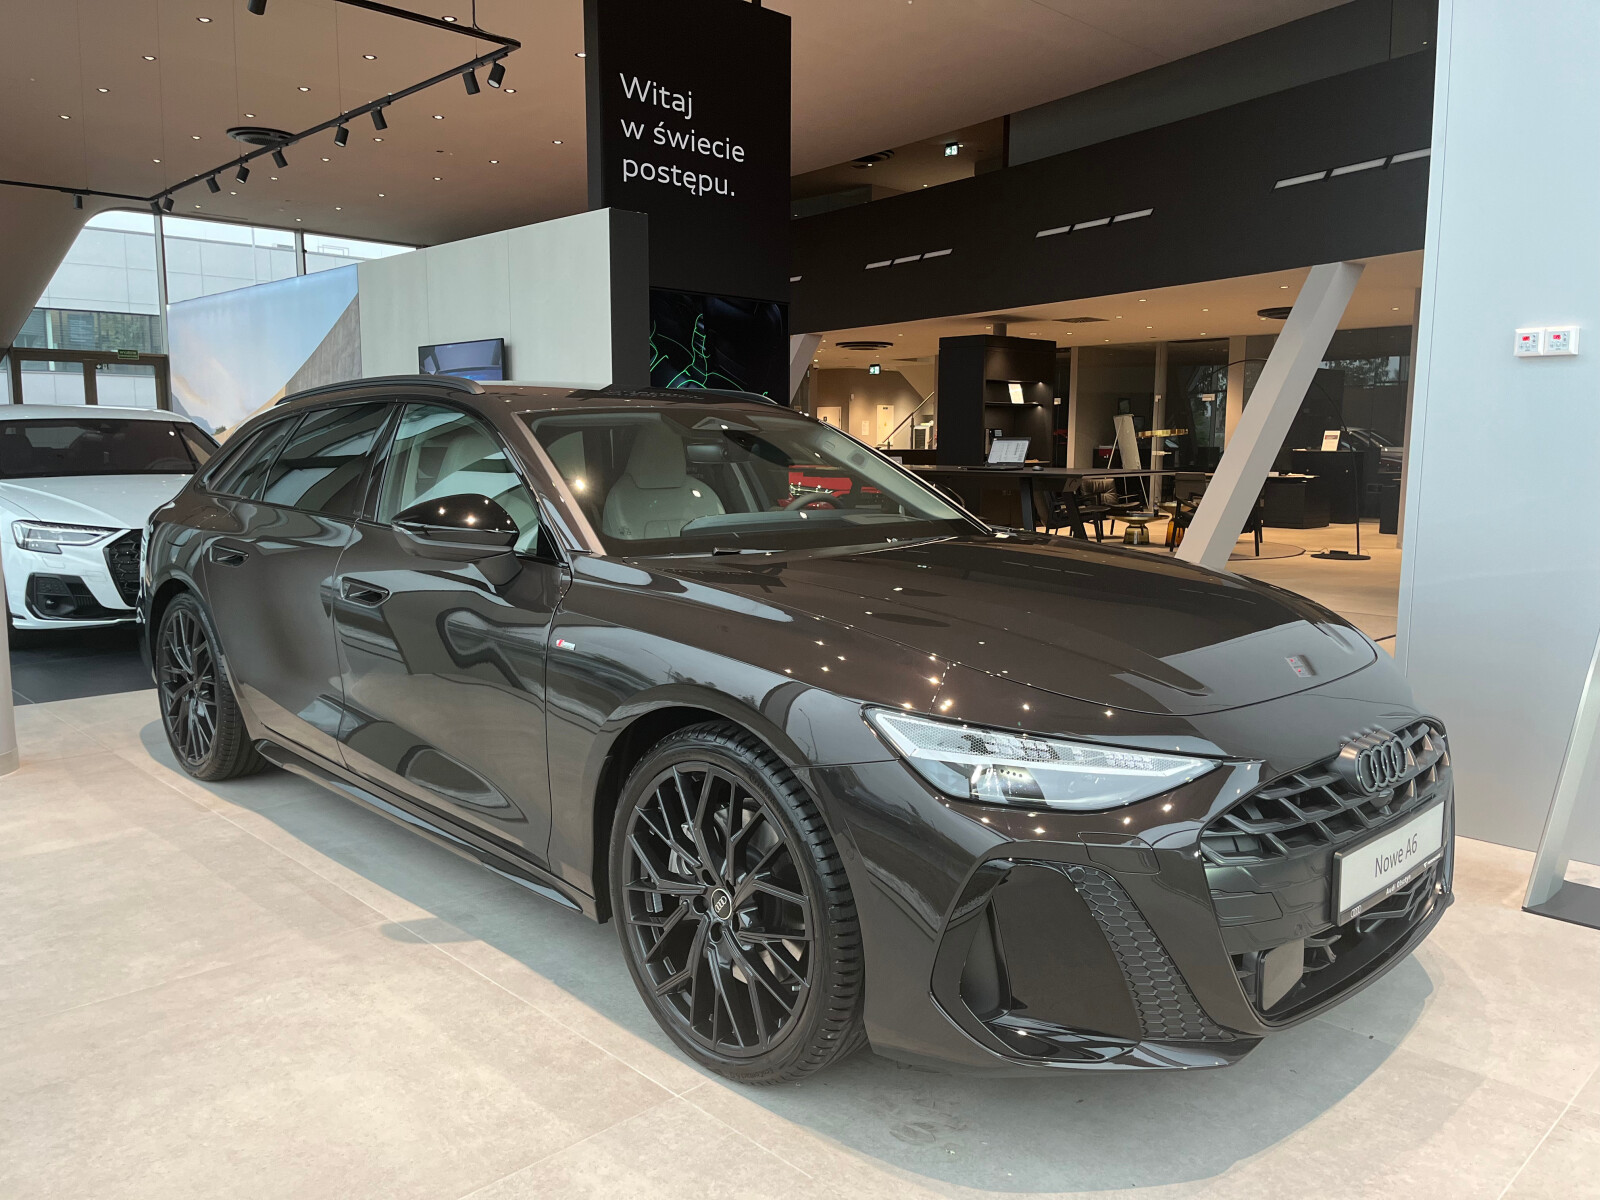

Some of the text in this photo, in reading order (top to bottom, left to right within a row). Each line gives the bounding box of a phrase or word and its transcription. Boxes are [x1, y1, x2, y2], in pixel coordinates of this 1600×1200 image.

[620, 72, 692, 120] Witaj
[620, 118, 745, 162] w świecie
[623, 158, 735, 196] postępu.
[1375, 848, 1403, 878] Nowe
[1405, 833, 1418, 859] A6
